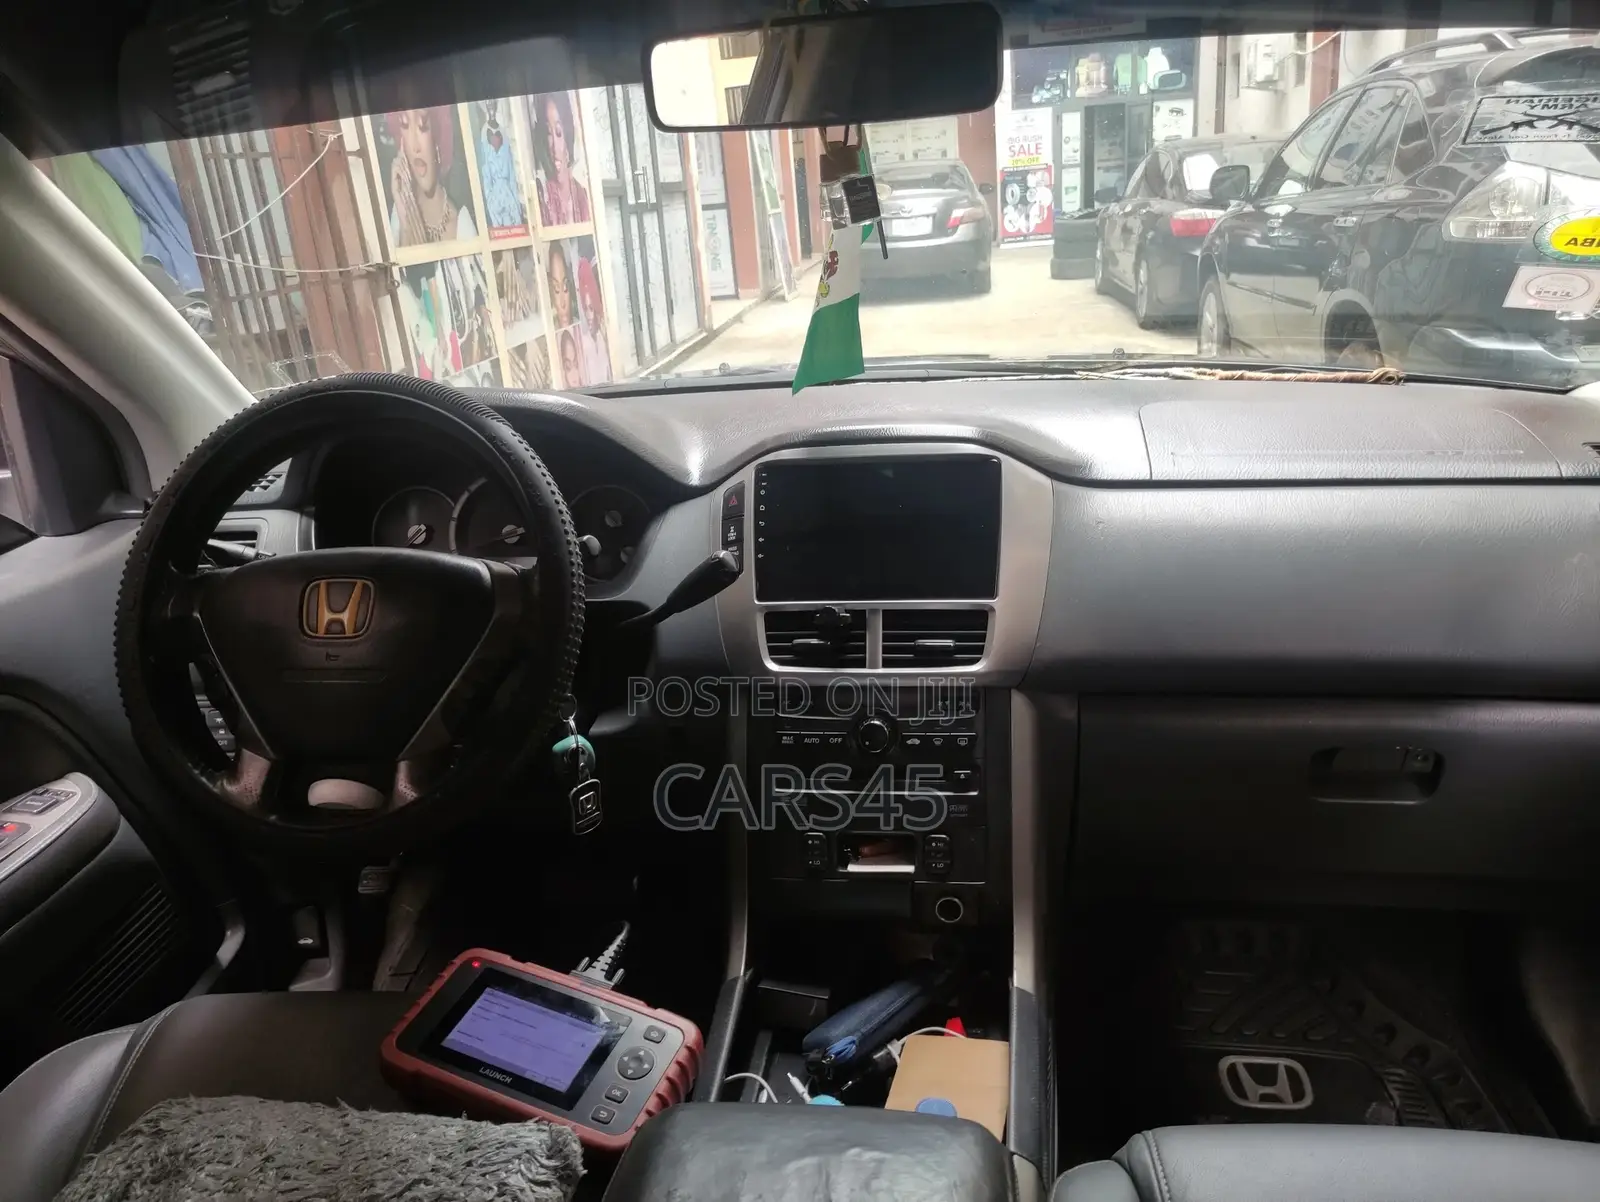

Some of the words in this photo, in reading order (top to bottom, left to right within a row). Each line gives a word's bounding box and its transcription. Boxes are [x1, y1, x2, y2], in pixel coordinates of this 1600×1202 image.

[1008, 142, 1043, 158] SALE
[478, 1066, 513, 1084] LAUNCH
[611, 1088, 622, 1097] OK
